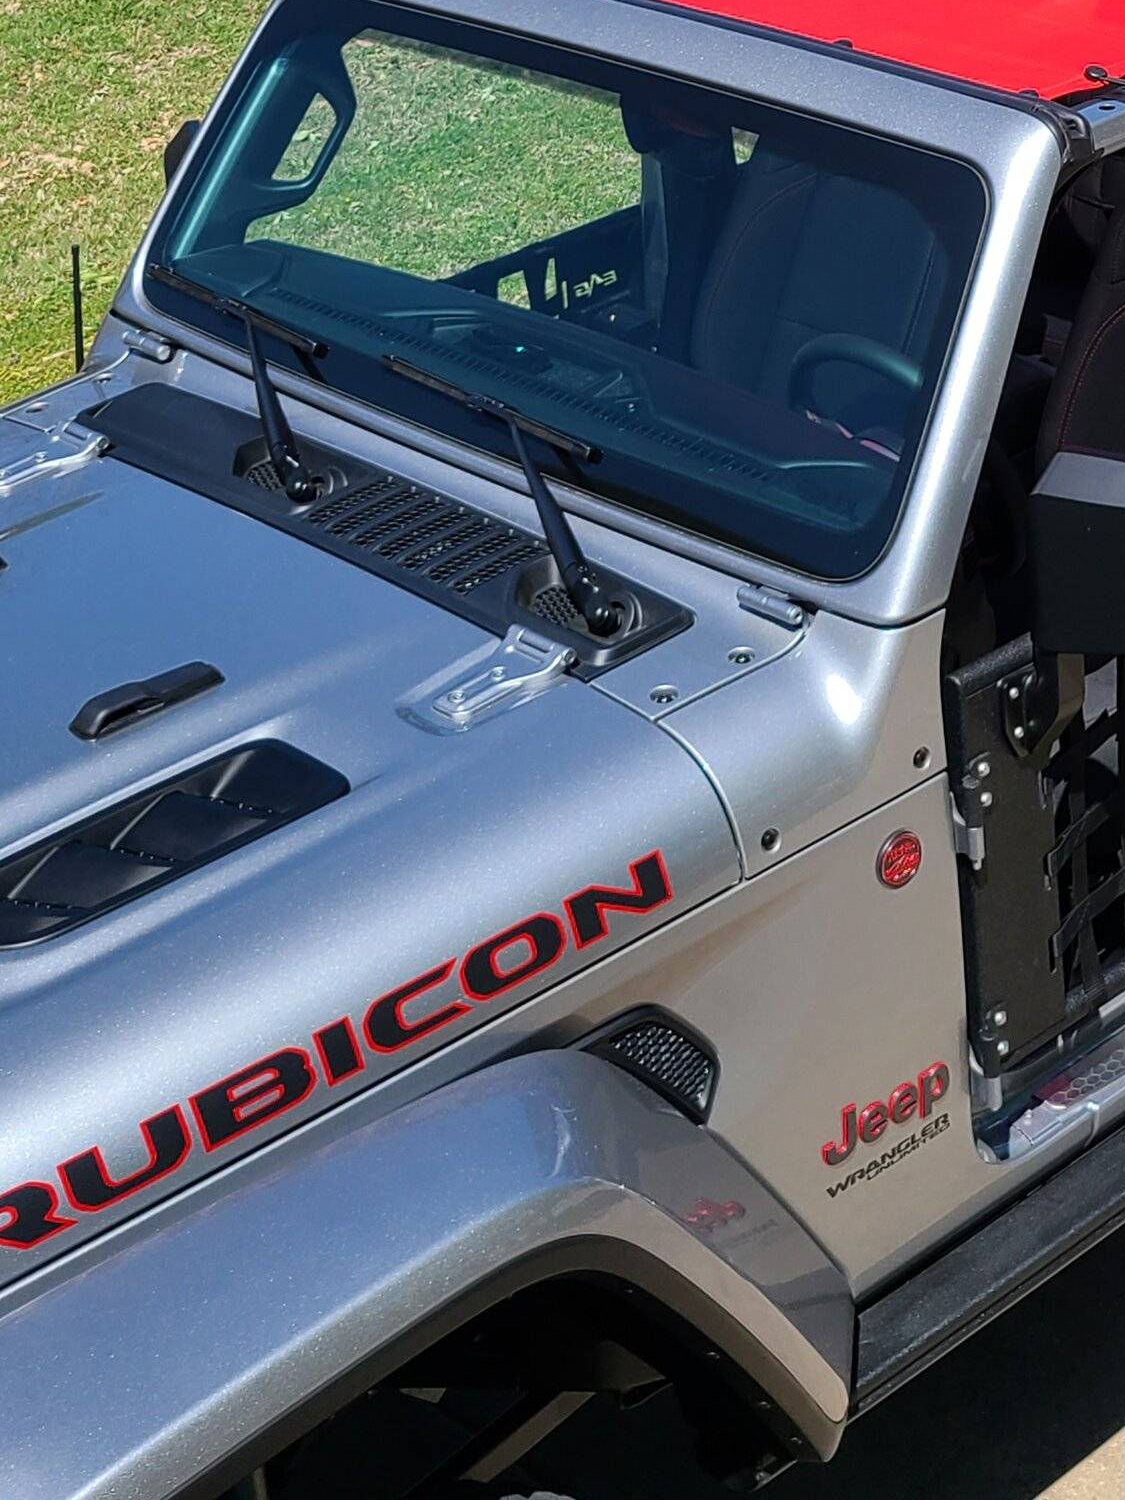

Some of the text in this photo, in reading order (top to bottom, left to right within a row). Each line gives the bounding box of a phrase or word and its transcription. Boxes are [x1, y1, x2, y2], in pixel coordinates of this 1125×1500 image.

[821, 1061, 950, 1166] Jeep
[826, 1112, 949, 1198] WRANGLER
[866, 1122, 950, 1181] UNLIMITED
